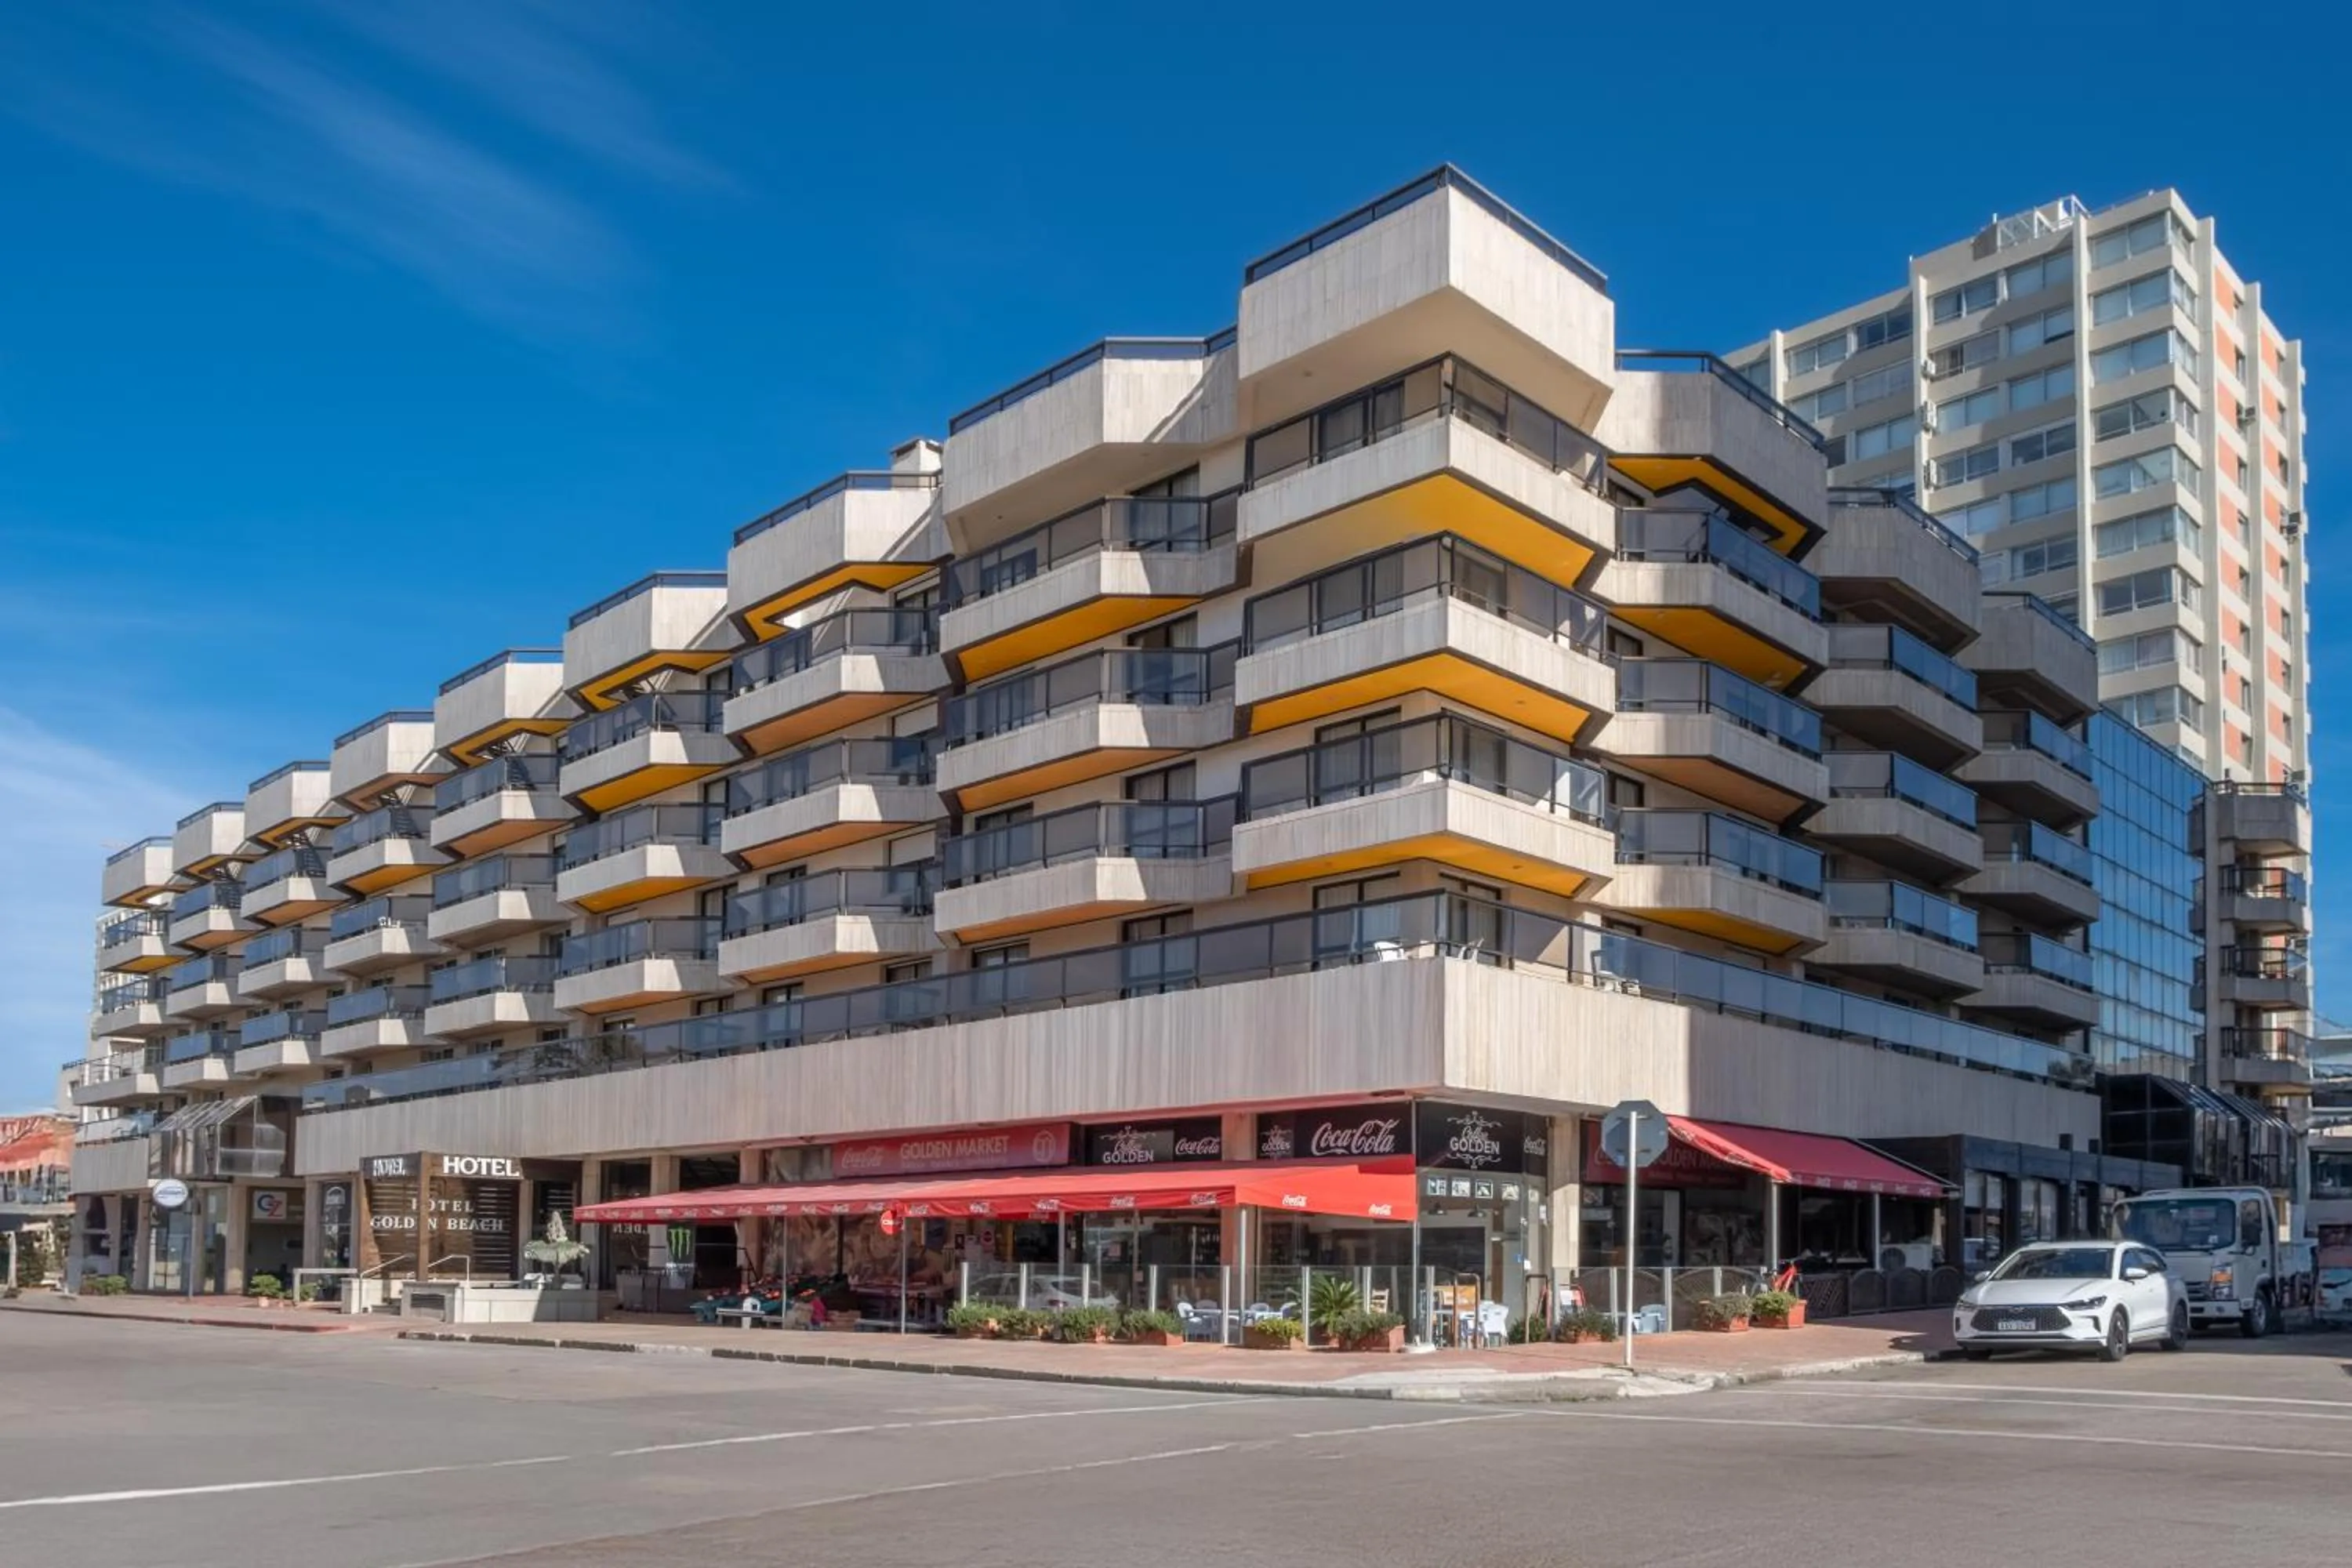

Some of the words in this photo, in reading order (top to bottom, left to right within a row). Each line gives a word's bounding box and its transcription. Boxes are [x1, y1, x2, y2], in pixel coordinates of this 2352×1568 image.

[1175, 1137, 1221, 1155] Coca-Cola
[1311, 1119, 1401, 1156] Coca-Cola
[1450, 1137, 1500, 1155] GOLDEN
[902, 1140, 953, 1160] GOLDEN
[956, 1135, 1010, 1156] MARKET
[1102, 1149, 1155, 1164] GOLDEN
[443, 1155, 521, 1177] HOTEL
[370, 1216, 438, 1230] GOLDN
[447, 1217, 503, 1231] BEACH
